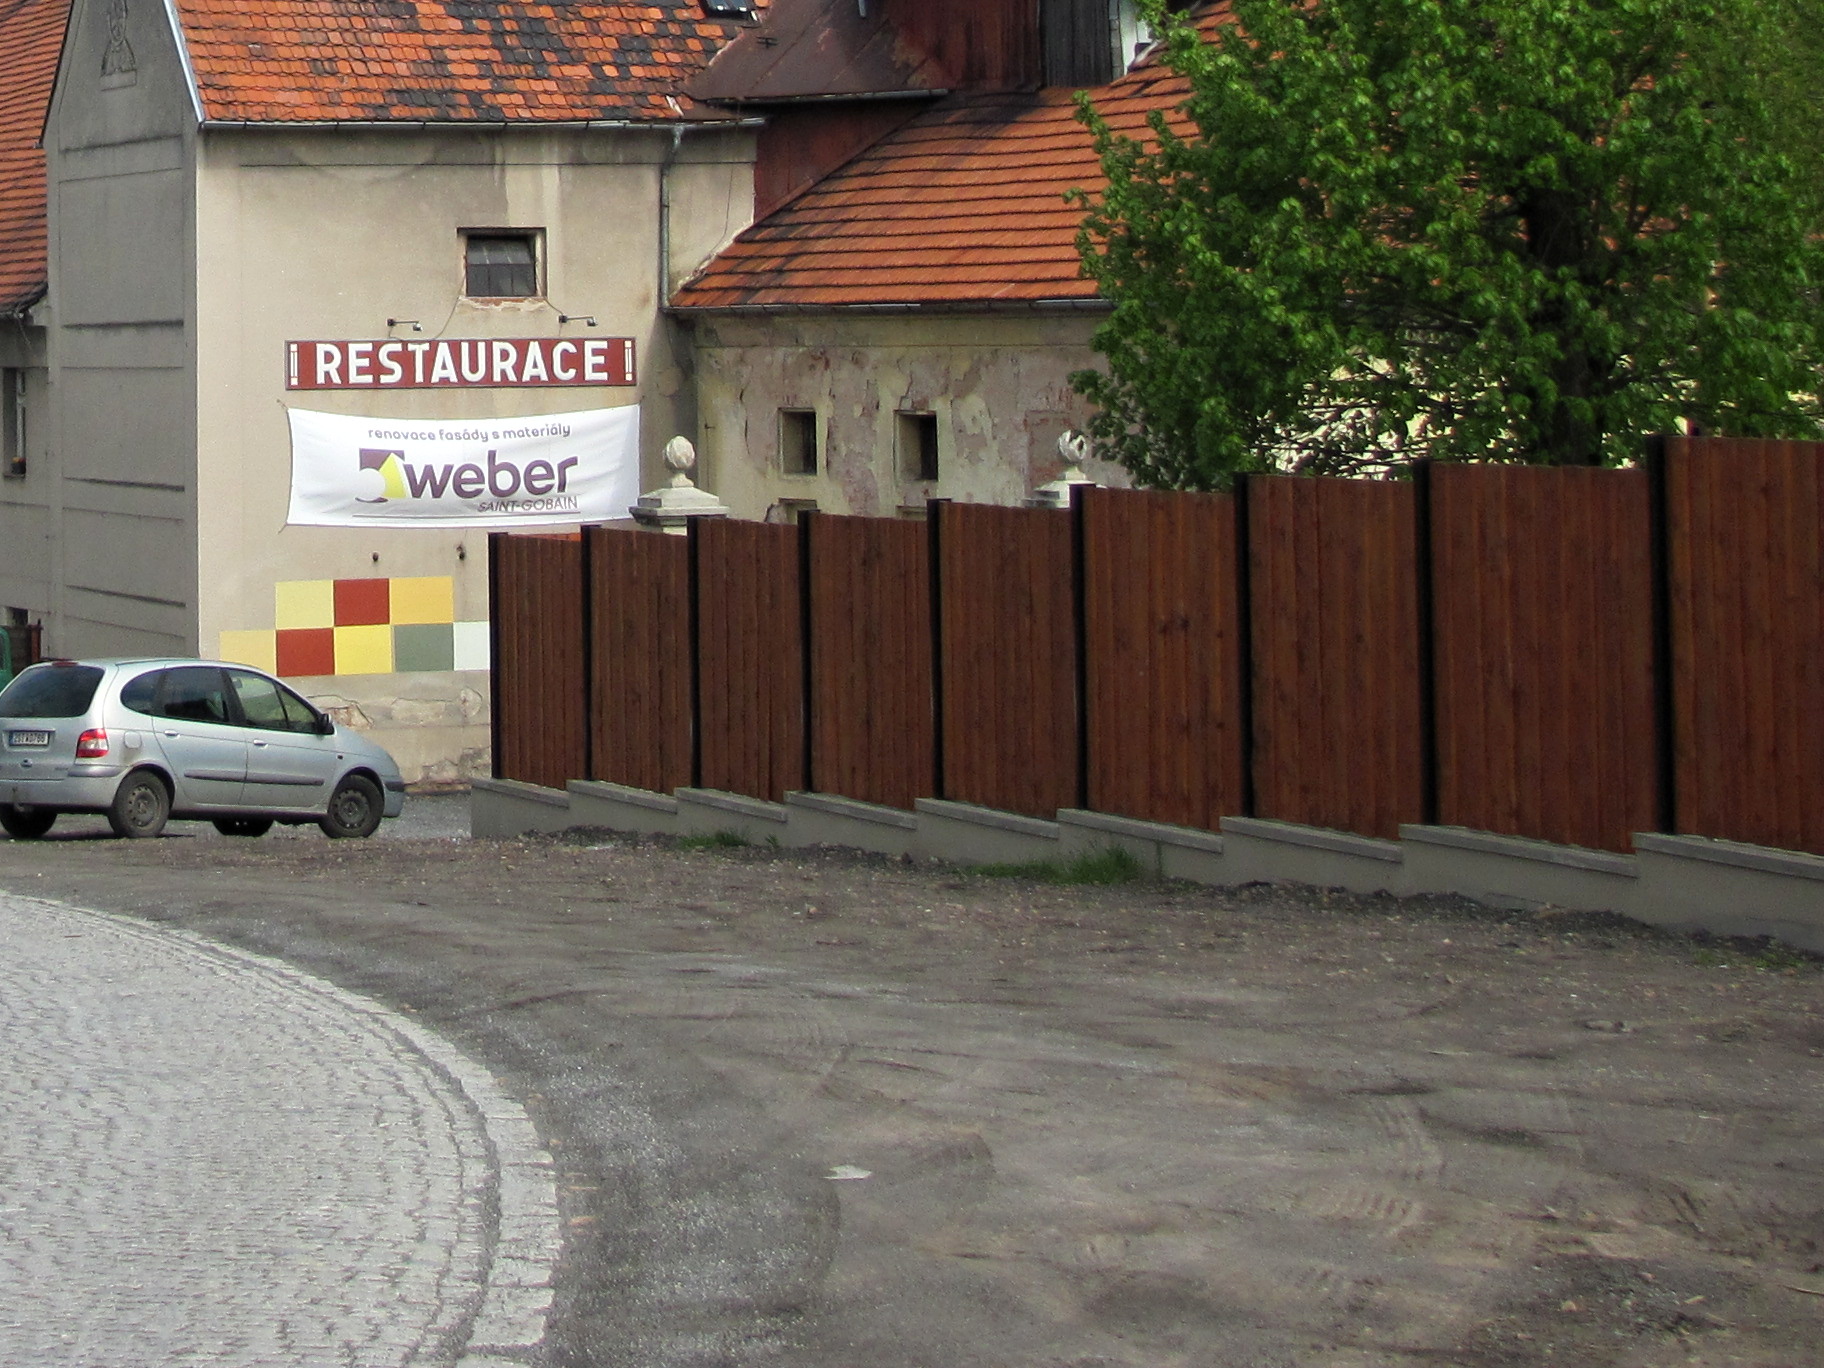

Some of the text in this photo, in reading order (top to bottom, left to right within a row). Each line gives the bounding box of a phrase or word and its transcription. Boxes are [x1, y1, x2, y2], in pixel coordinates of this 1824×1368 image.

[315, 341, 609, 385] RESTAURACE
[367, 423, 571, 443] renovace fasády s materiály
[403, 449, 578, 499] weber
[478, 496, 578, 513] SAINT-GOBAIN
